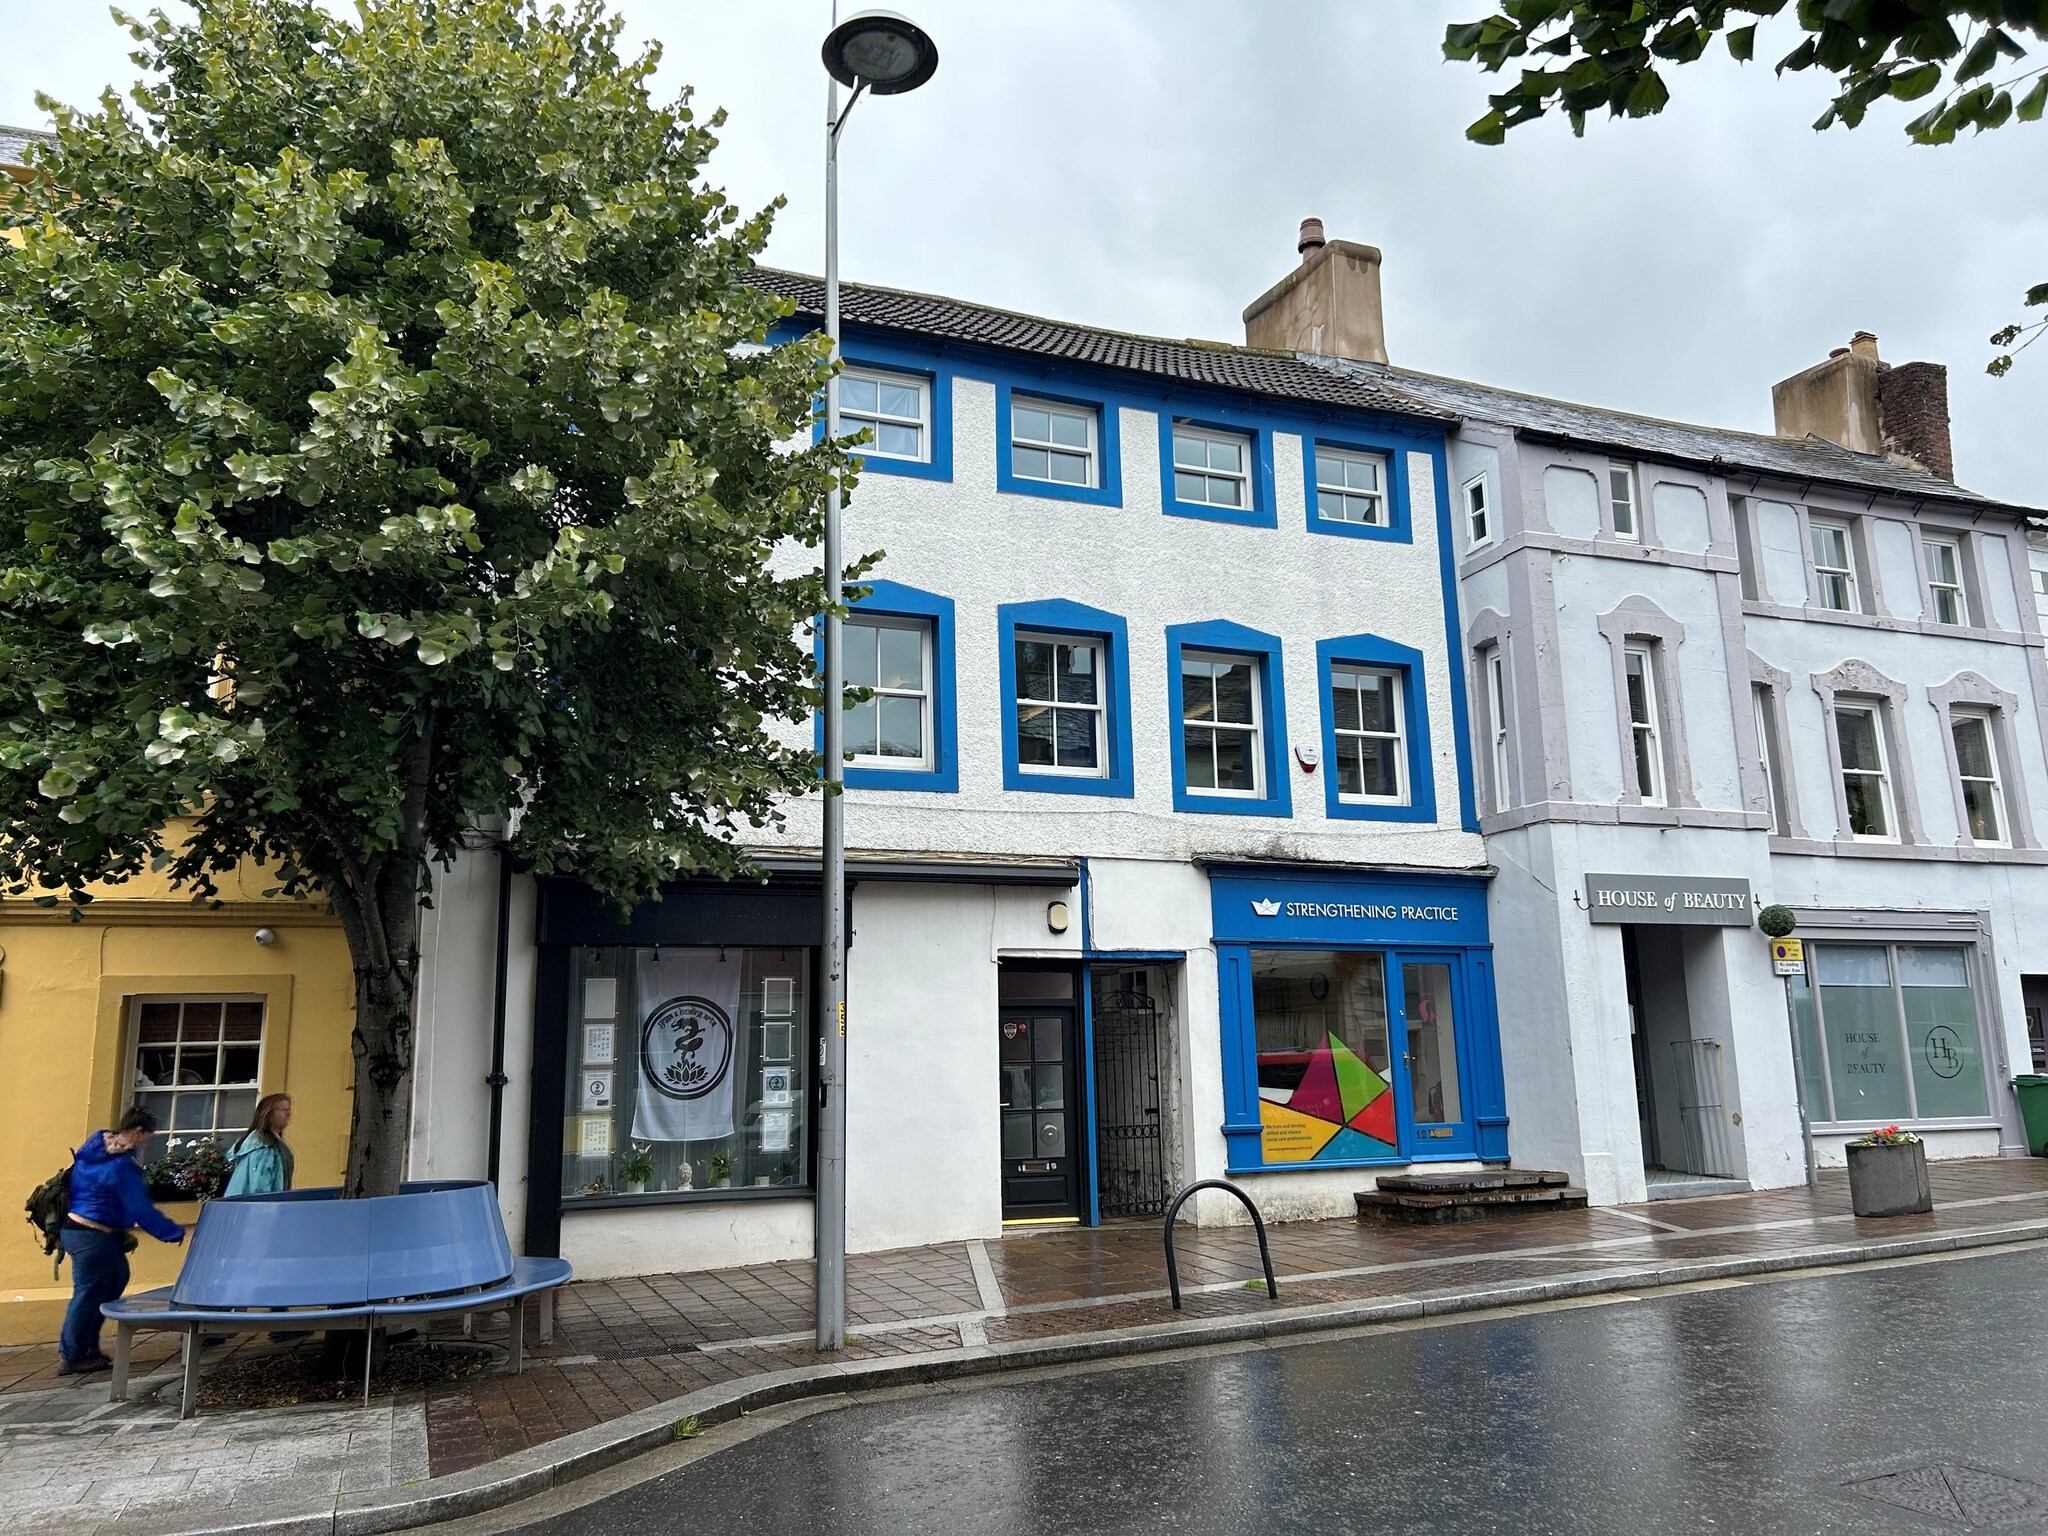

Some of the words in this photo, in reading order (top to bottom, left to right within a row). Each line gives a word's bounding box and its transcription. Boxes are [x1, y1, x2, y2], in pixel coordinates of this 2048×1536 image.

[1597, 889, 1658, 908] HOUSE
[1664, 892, 1679, 912] of
[1683, 892, 1746, 910] BEAUTY
[1286, 902, 1397, 919] STRENGTHENING
[1401, 906, 1459, 921] PRACTICE
[1845, 1032, 1881, 1044] HOUSE
[1861, 1046, 1870, 1060] of
[1847, 1063, 1886, 1074] BEAUTY
